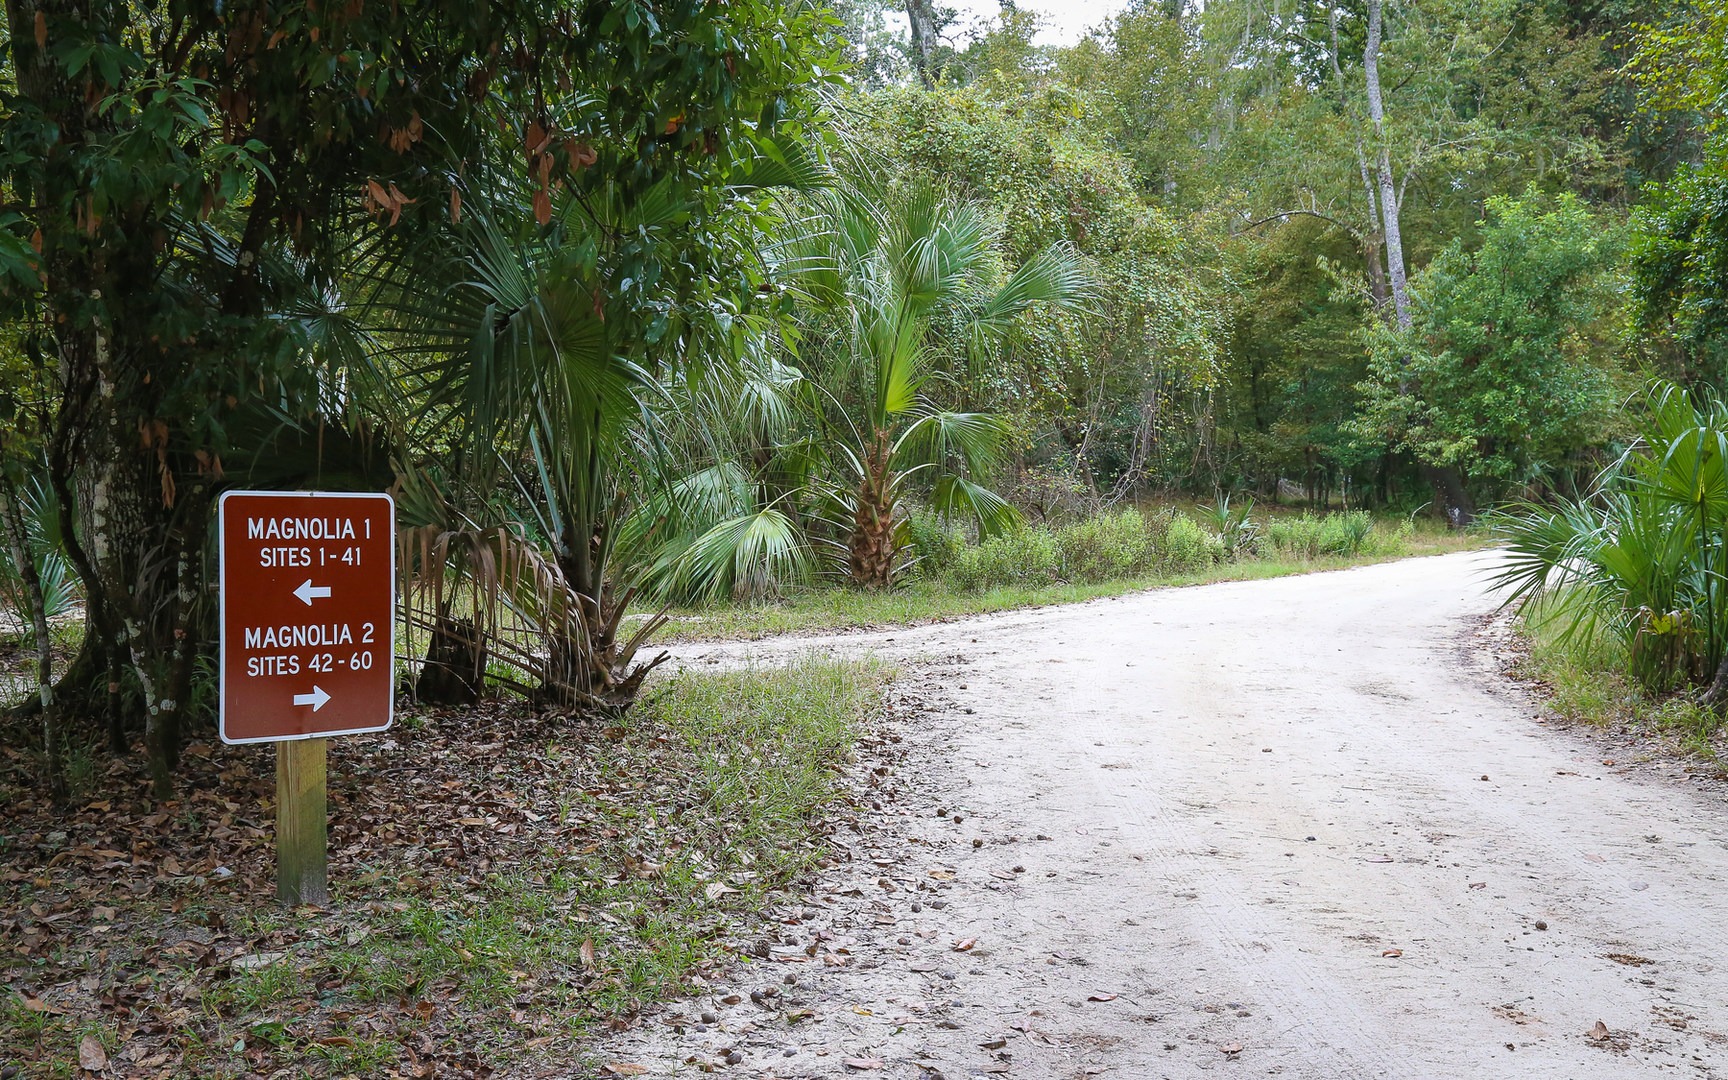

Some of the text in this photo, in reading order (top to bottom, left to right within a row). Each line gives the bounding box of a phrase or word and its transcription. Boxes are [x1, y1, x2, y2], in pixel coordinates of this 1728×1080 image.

[248, 517, 370, 540] MAGNOLIA 1
[259, 547, 311, 567] SITES
[245, 622, 374, 649] MAGNOLIA 2
[247, 654, 300, 677] SITES
